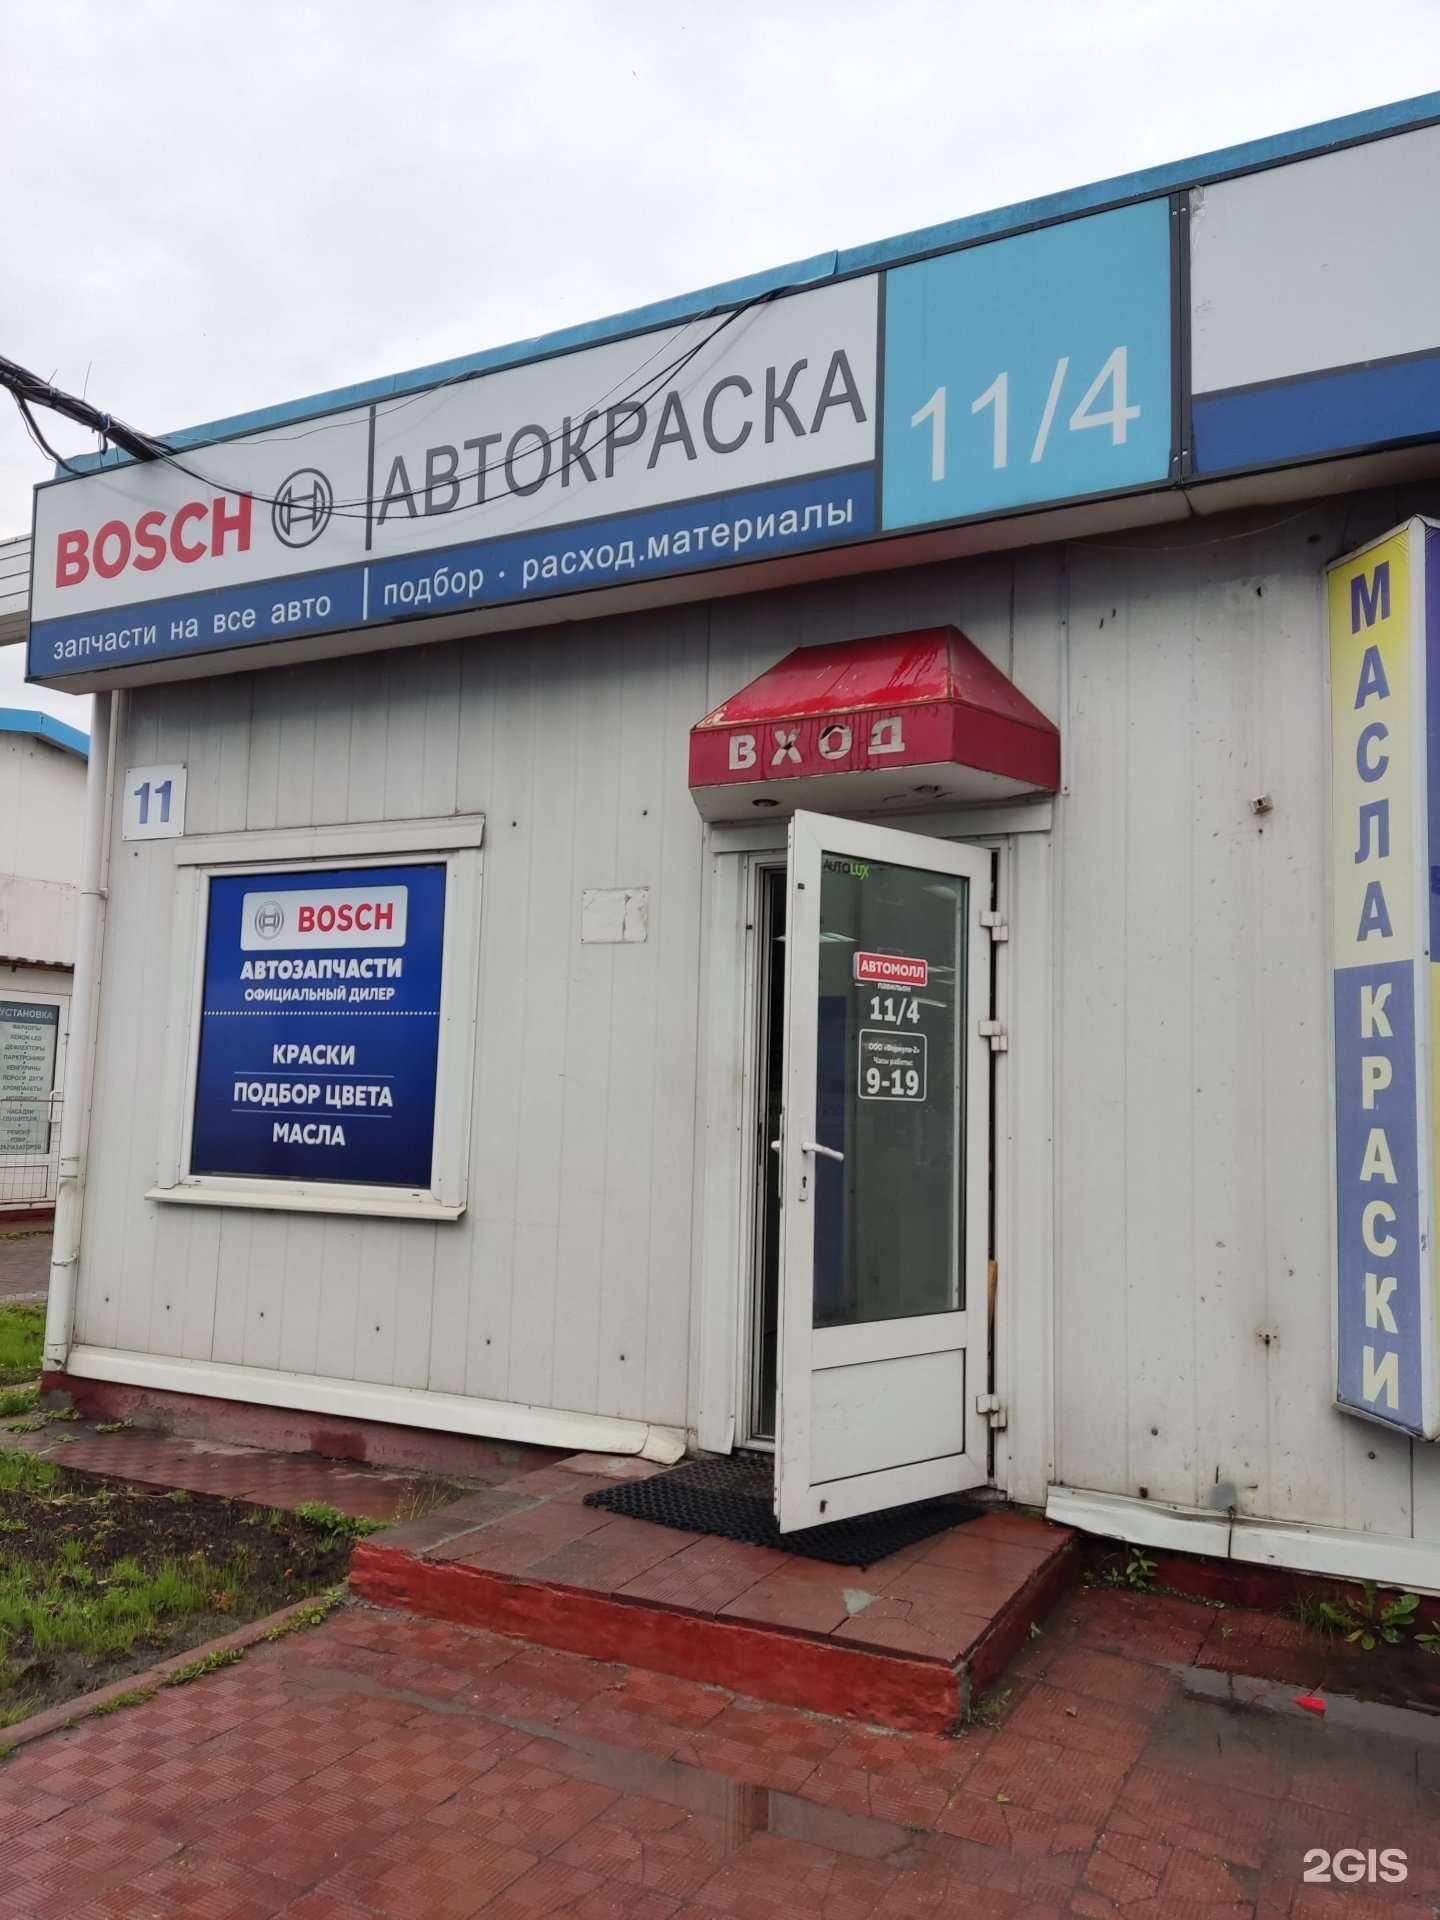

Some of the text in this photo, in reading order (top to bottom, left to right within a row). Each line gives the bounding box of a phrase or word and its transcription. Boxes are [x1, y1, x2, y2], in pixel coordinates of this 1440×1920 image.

[911, 346, 1141, 482] 11/4
[376, 349, 867, 526] АВТОКРАСКА
[55, 491, 252, 588] BOSCH
[384, 498, 853, 606] подбор расход.материалы
[53, 594, 332, 661] запчасти на все авто
[728, 716, 906, 770] ВХОД
[1350, 560, 1393, 942] МАСЛА
[133, 780, 172, 824] 11
[298, 902, 394, 932] BOSCH
[240, 958, 402, 980] АВТОЗАПЧАСТИ
[860, 960, 925, 979] АВТОМОЛЛ
[244, 985, 395, 1003] ОФИЦИАЛЬНЫЙ ДИЛЕР
[870, 996, 920, 1025] 11/4
[272, 1044, 355, 1066] КРАСКИ
[233, 1082, 393, 1108] ПОДБОР ЦВЕТА
[866, 1067, 919, 1096] 9-19
[272, 1122, 346, 1146] МАСЛА
[1360, 982, 1399, 1410] КРАСКИ
